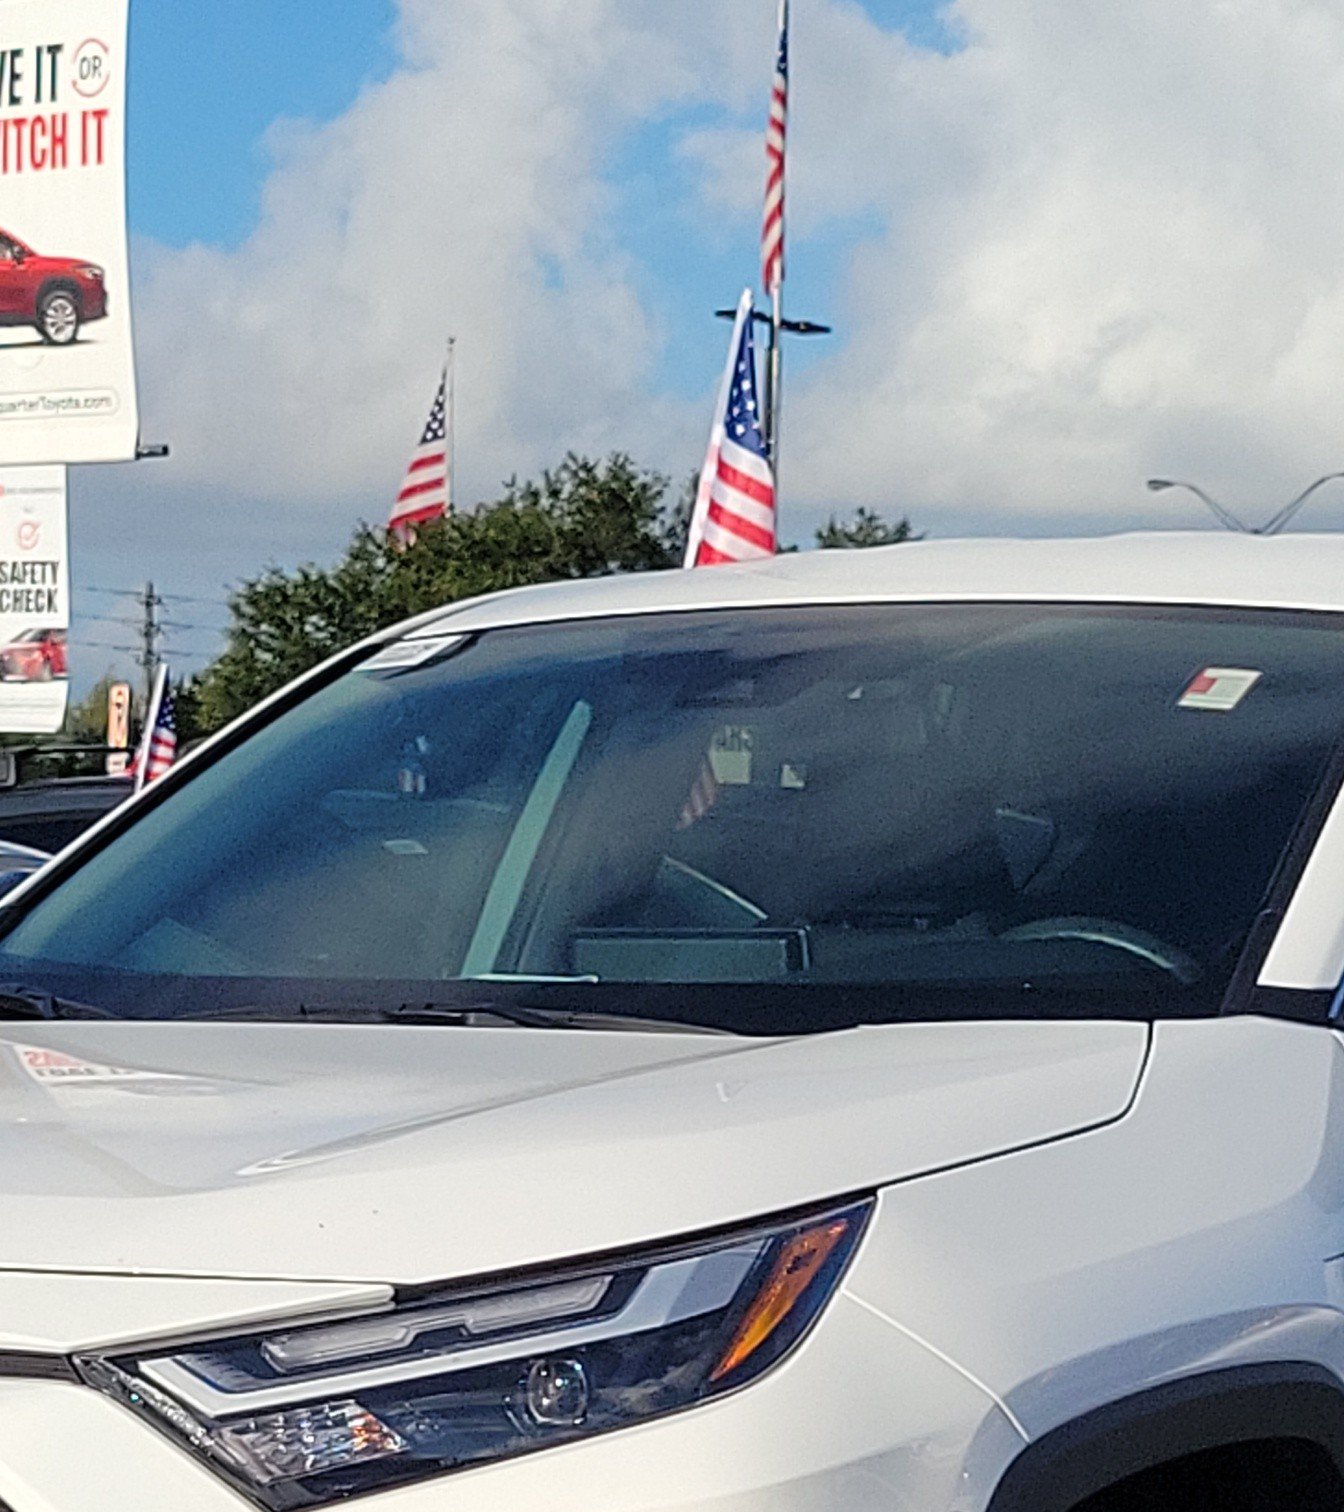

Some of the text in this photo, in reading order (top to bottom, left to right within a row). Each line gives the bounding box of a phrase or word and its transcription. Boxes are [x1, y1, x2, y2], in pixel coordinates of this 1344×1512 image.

[34, 43, 64, 103] IT
[77, 53, 103, 82] OR
[80, 108, 110, 167] IT
